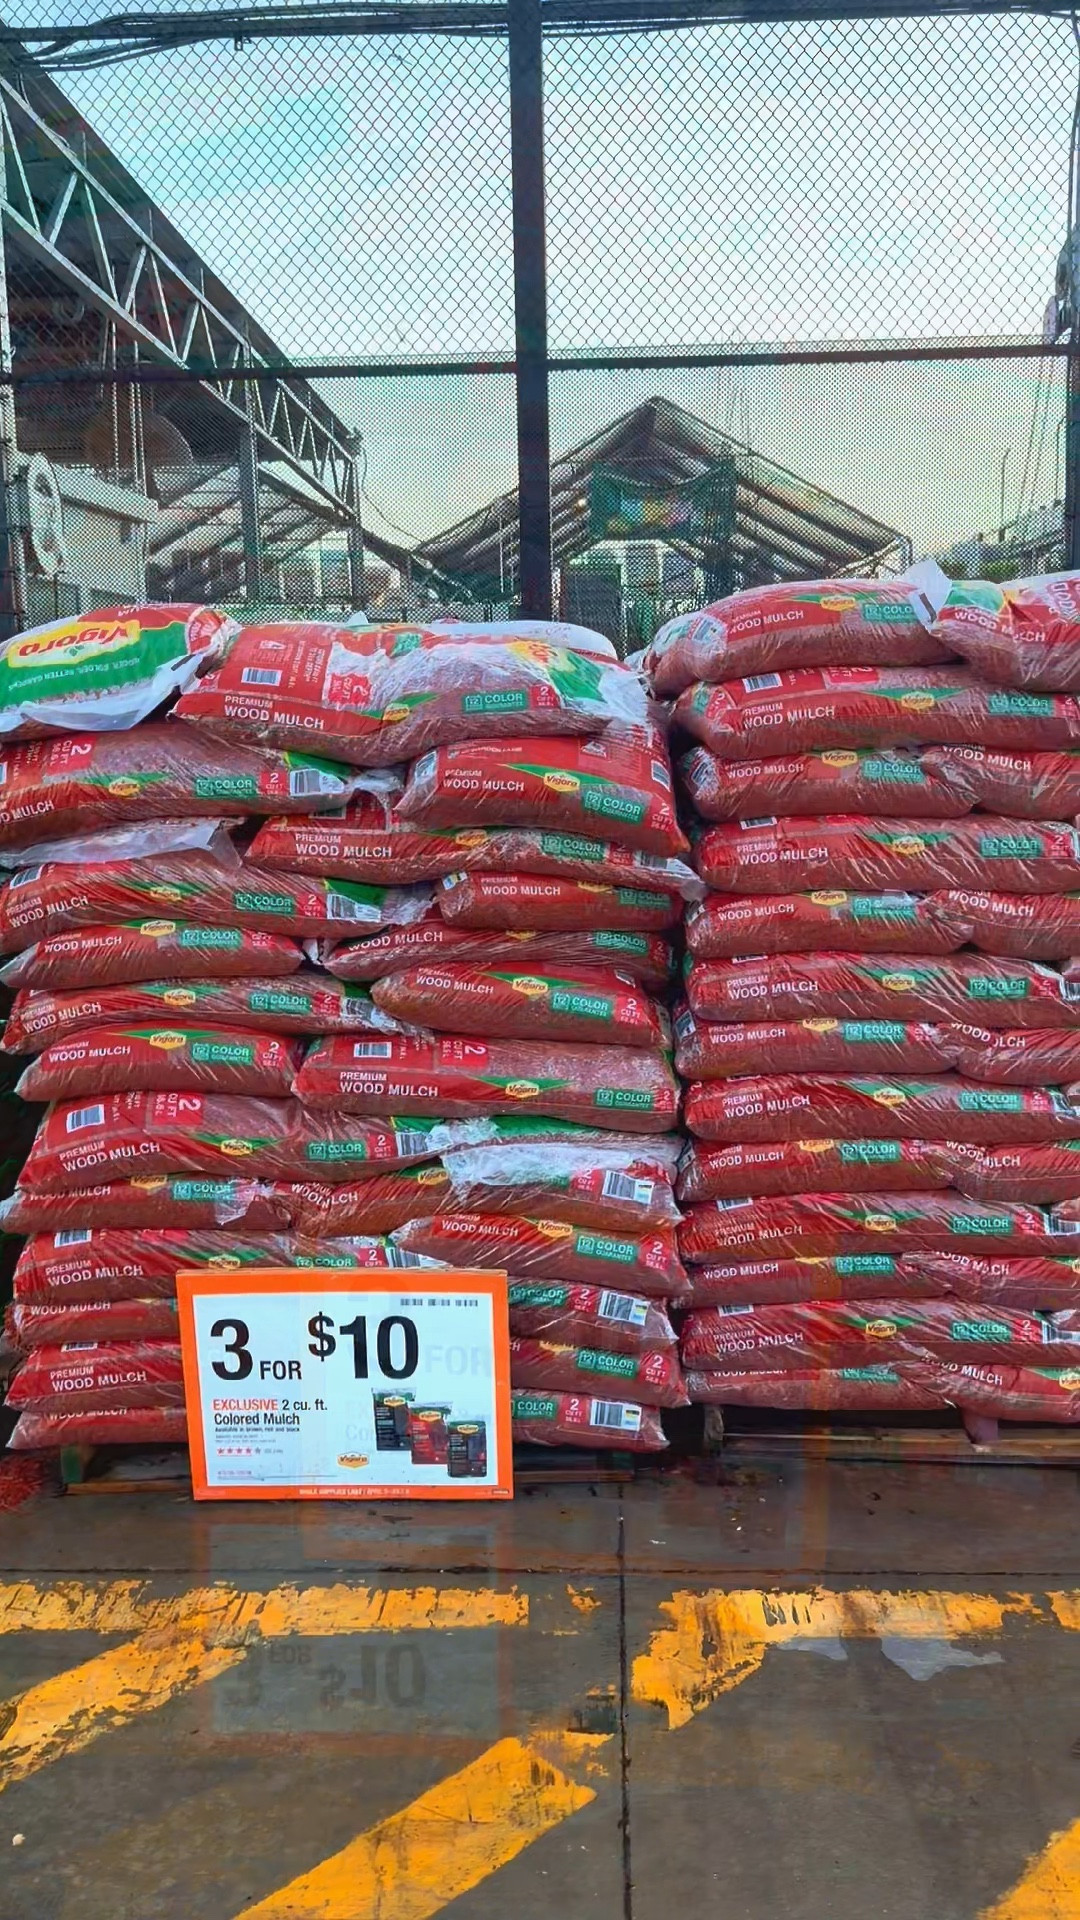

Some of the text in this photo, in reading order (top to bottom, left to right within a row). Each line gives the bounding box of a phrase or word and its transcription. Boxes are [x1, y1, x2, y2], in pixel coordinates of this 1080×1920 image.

[764, 610, 804, 623] MULCH
[955, 612, 997, 629] WOOD
[18, 626, 130, 656] Vigoro
[540, 686, 548, 695] 2
[225, 695, 273, 708] PREMIUM
[484, 694, 522, 703] COLOR
[224, 705, 324, 729] WOOD MULCH
[744, 705, 835, 729] WOOD MULCH
[884, 763, 921, 773] COLOR
[988, 754, 1031, 771] MULCH
[727, 764, 804, 778] WOOD MULCH
[269, 773, 279, 782] 2
[546, 776, 577, 787] Vigoro
[215, 779, 252, 789] COLOR
[443, 780, 524, 791] WOOD MULCH
[588, 793, 640, 814] 12 COLOR
[661, 803, 669, 814] 2
[13, 800, 54, 821] MULCH
[295, 833, 341, 843] PREMIUM
[1056, 836, 1063, 844] 2
[296, 844, 392, 857] WOOD MULCH
[564, 840, 601, 851] COLOR
[736, 842, 778, 852] PREMIUM
[1001, 839, 1038, 850] COLOR
[738, 848, 828, 865] WOOD MULCH
[482, 886, 560, 895] WOOD MULCH
[254, 897, 291, 907] COLOR
[307, 895, 317, 904] 2
[949, 891, 1034, 916] WOOD MULCH
[6, 897, 42, 916] PREMIUM
[10, 896, 89, 928] WOOD MULCH
[718, 904, 794, 921] WOOD MULCH
[202, 931, 238, 940] COLOR
[398, 932, 442, 944] MULCH
[613, 934, 646, 947] COLOR
[44, 936, 122, 953] WOOD MULCH
[415, 976, 494, 994] WOOD MULCH
[514, 980, 547, 990] Vigoro
[726, 975, 768, 988] PREMIUM
[728, 981, 818, 999] WOOD MULCH
[270, 995, 307, 1005] COLOR
[572, 997, 608, 1011] COLOR
[627, 999, 637, 1009] 2
[24, 1002, 101, 1032] WOOD MULCH
[863, 1025, 901, 1034] COLOR
[153, 1033, 184, 1044] Vigoro
[710, 1029, 785, 1043] WOOD MULCH
[211, 1045, 249, 1057] COLOR
[268, 1041, 279, 1053] 2
[49, 1045, 130, 1062] WOOD MULCH
[340, 1072, 387, 1081] PREMIUM
[340, 1082, 438, 1097] WOOD MULCH
[508, 1085, 538, 1094] Vigoro
[615, 1092, 650, 1102] COLOR
[722, 1093, 762, 1106] PREMIUM
[980, 1094, 1017, 1104] COLOR
[724, 1096, 810, 1118] WOOD MULCH
[377, 1135, 385, 1146] 2
[58, 1140, 105, 1160] PREMIUM
[328, 1143, 362, 1154] COLOR
[860, 1145, 895, 1154] COLOR
[62, 1142, 160, 1172] WOOD MULCH
[709, 1152, 784, 1169] WOOD MULCH
[441, 1220, 519, 1236] WOOD MULCH
[972, 1219, 1008, 1228] COLOR
[717, 1226, 803, 1246] WOOD MULCH
[580, 1239, 634, 1253] 12 COLOR
[653, 1242, 662, 1254] 2
[314, 1257, 351, 1266] COLOR
[853, 1256, 890, 1265] COLOR
[46, 1259, 92, 1275] PREMIUM
[703, 1264, 779, 1279] WOOD MULCH
[48, 1265, 143, 1286] WOOD MULCH
[581, 1289, 590, 1299] 2
[30, 1302, 111, 1315] WOOD MULCH
[1022, 1321, 1031, 1330] 2
[210, 1311, 419, 1380] 3 FOR $10
[716, 1333, 803, 1353] WOOD MULCH
[598, 1356, 634, 1368] COLOR
[653, 1355, 662, 1368] 2
[50, 1367, 94, 1379] PREMIUM
[961, 1365, 1003, 1385] MULCH
[52, 1371, 147, 1392] WOOD MULCH
[214, 1399, 328, 1411] EXCLUSIVE 2 cu. ft.
[518, 1401, 553, 1412] COLOR
[571, 1399, 579, 1409] 2
[214, 1413, 300, 1425] Colored Mulch
